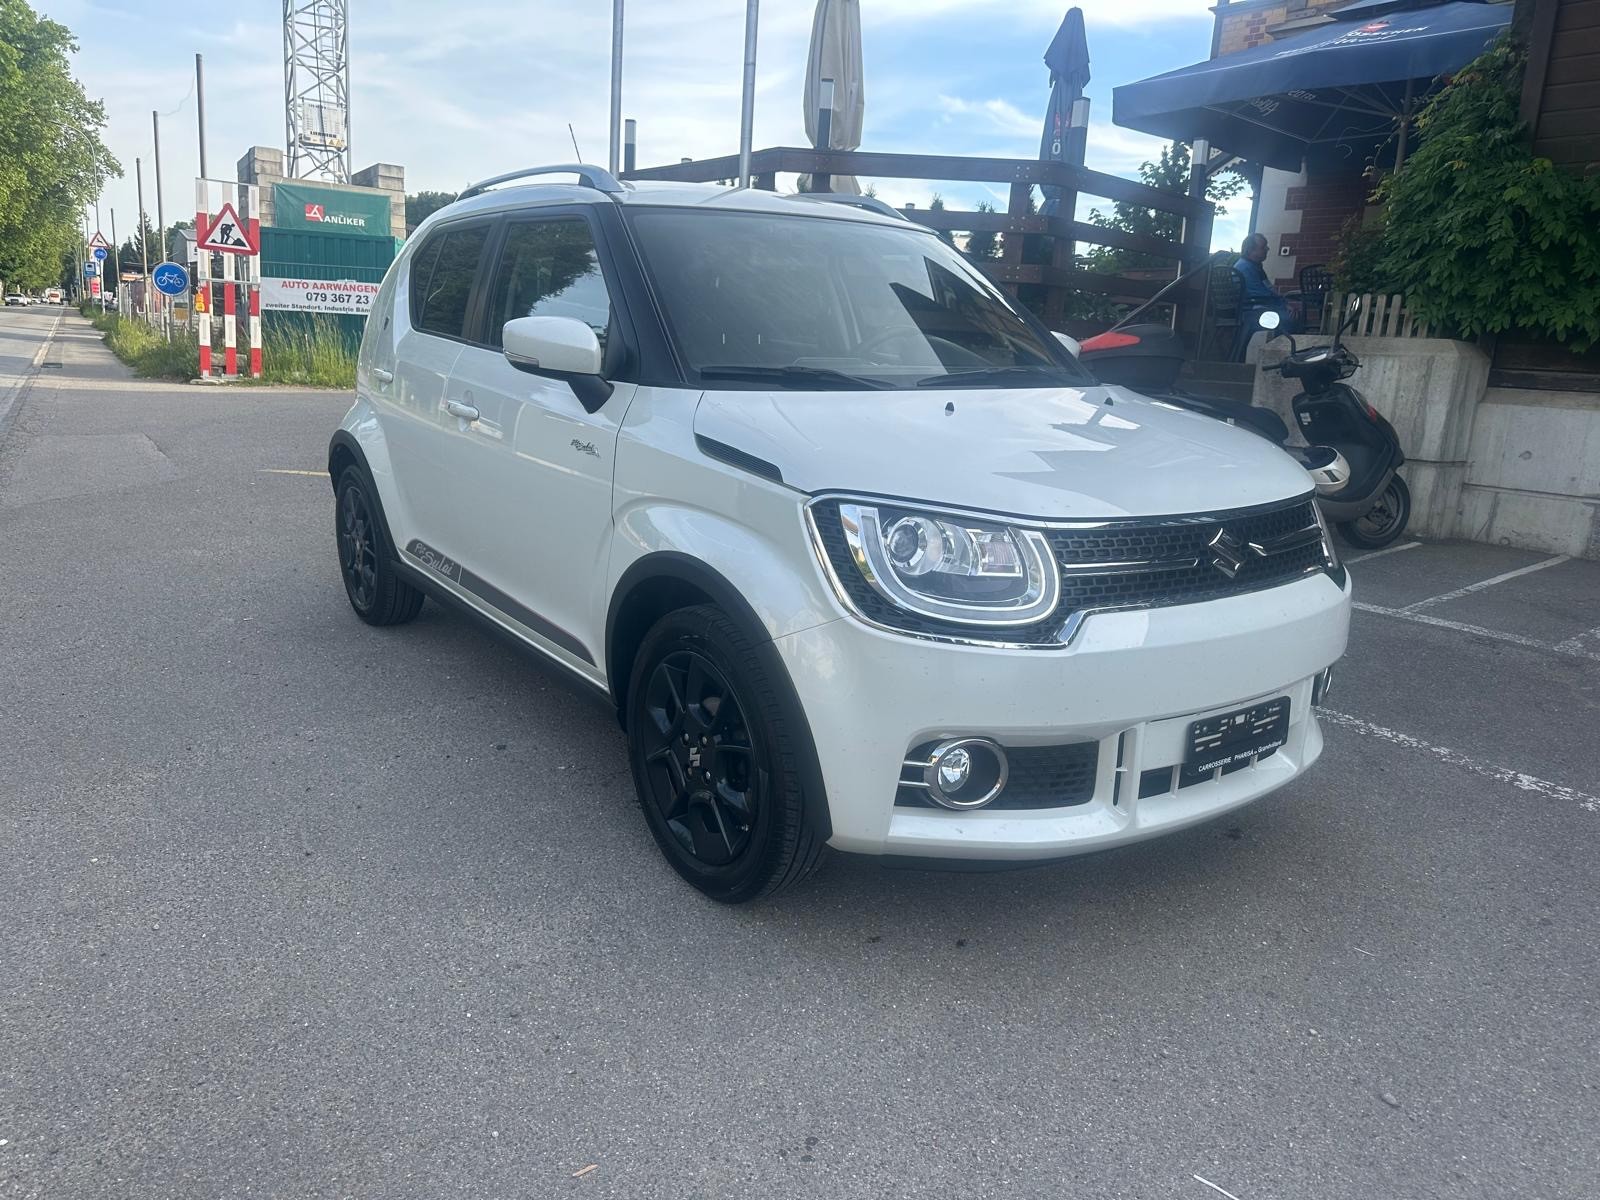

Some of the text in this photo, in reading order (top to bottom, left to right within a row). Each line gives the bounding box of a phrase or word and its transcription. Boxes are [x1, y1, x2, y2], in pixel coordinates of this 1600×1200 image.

[281, 281, 309, 290] AUTO
[305, 292, 369, 305] 079 367 23
[324, 305, 354, 313] Industrie
[1198, 756, 1231, 773] CARROSSERIE
